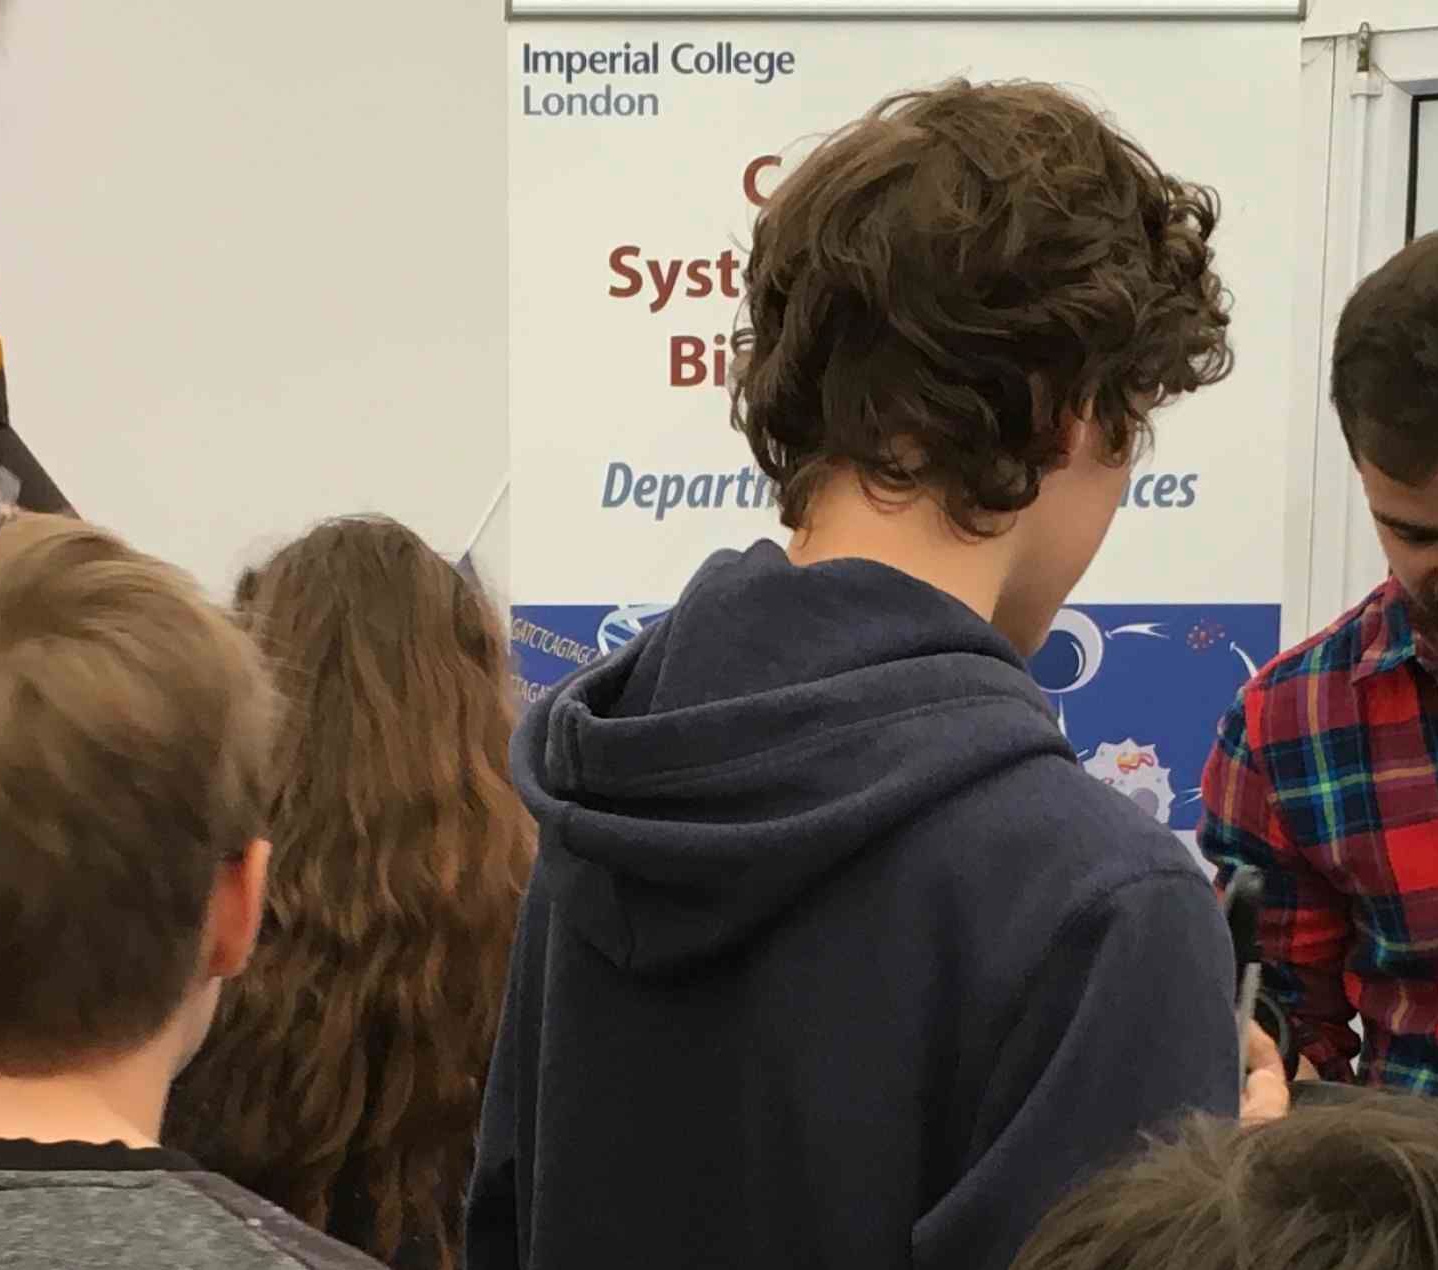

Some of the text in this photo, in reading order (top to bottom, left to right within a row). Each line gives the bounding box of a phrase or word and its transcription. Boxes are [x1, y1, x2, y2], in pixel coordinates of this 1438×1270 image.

[523, 41, 795, 84] Imperial College
[523, 84, 659, 116] London
